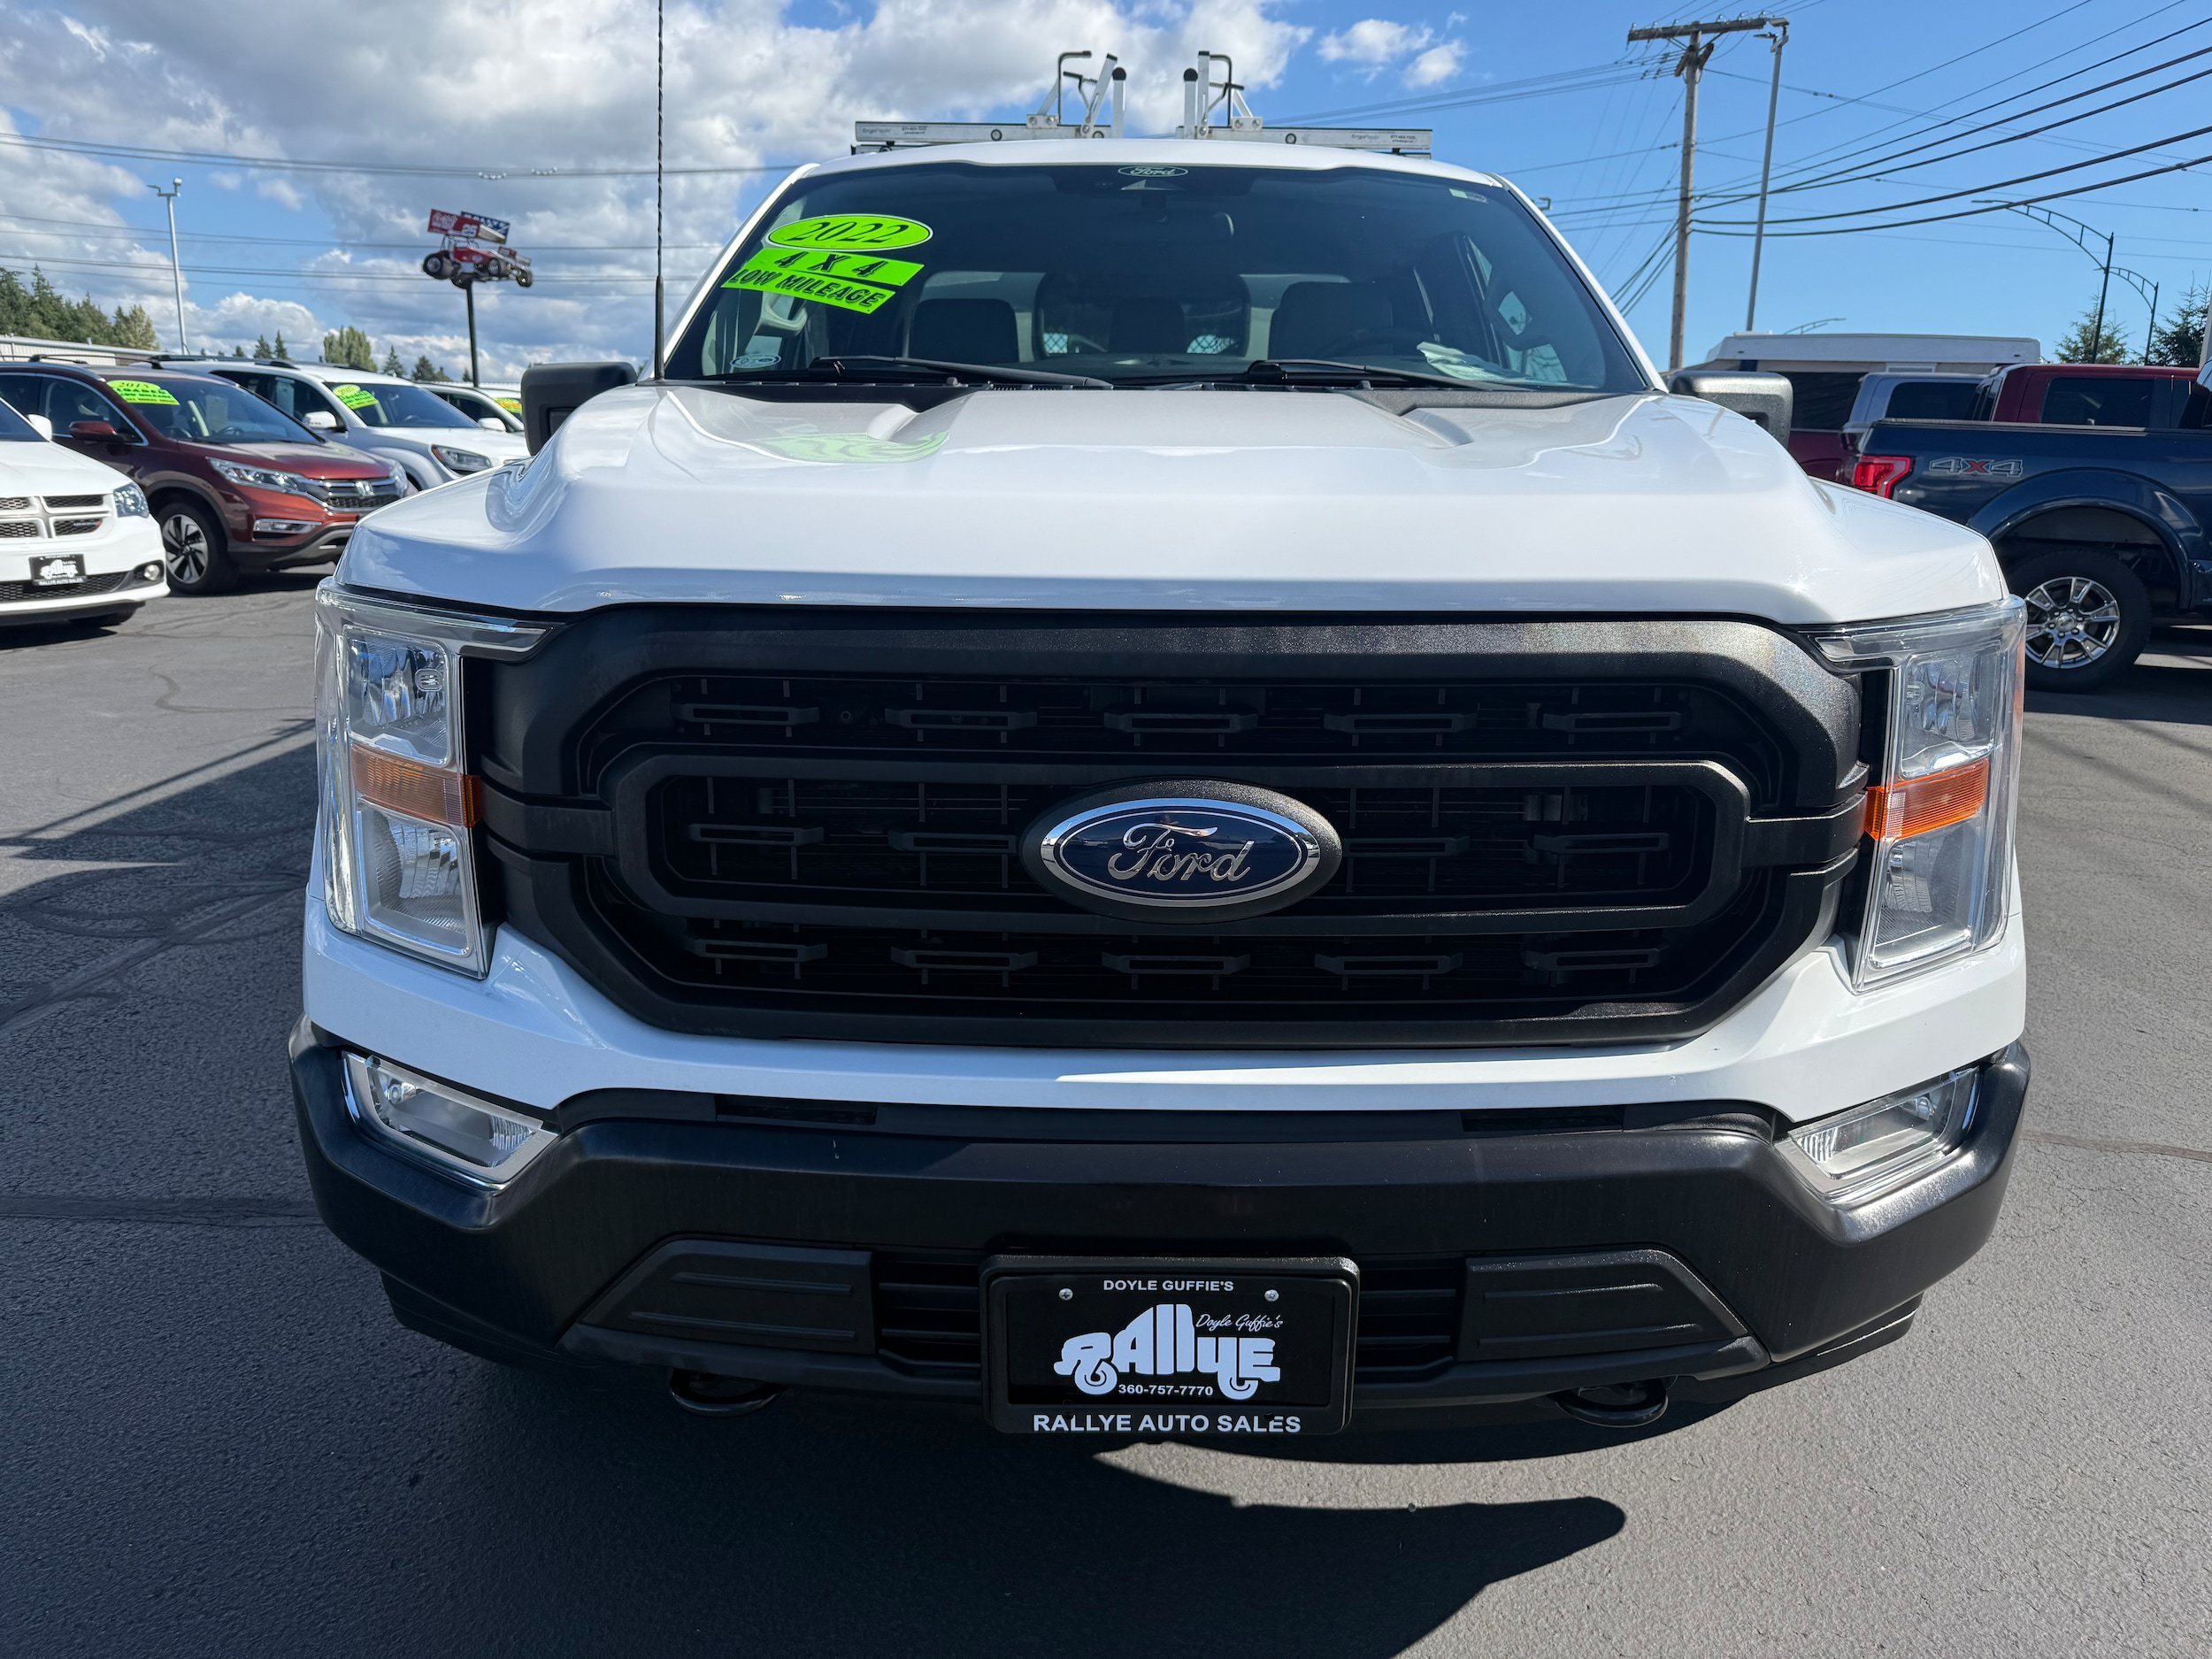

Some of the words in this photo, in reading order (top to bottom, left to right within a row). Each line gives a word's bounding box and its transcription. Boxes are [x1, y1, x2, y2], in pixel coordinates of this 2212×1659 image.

[1130, 166, 1176, 175] Ford
[786, 221, 910, 243] 2022
[775, 251, 809, 267] 4
[808, 254, 850, 272] X
[853, 261, 887, 277] 4
[728, 269, 782, 286] LOW
[776, 273, 886, 306] MILEAGE
[1108, 823, 1255, 881] Ford
[1103, 1279, 1157, 1291] DOYLE
[1162, 1280, 1234, 1292] GUFFIE'S
[1195, 1314, 1233, 1332] Doyle
[1235, 1314, 1284, 1333] Guffie's
[1118, 1384, 1214, 1396] 360-757-7770
[1033, 1414, 1132, 1432] RALLYE
[1138, 1415, 1210, 1432] AUTO
[1217, 1416, 1302, 1432] SALES
